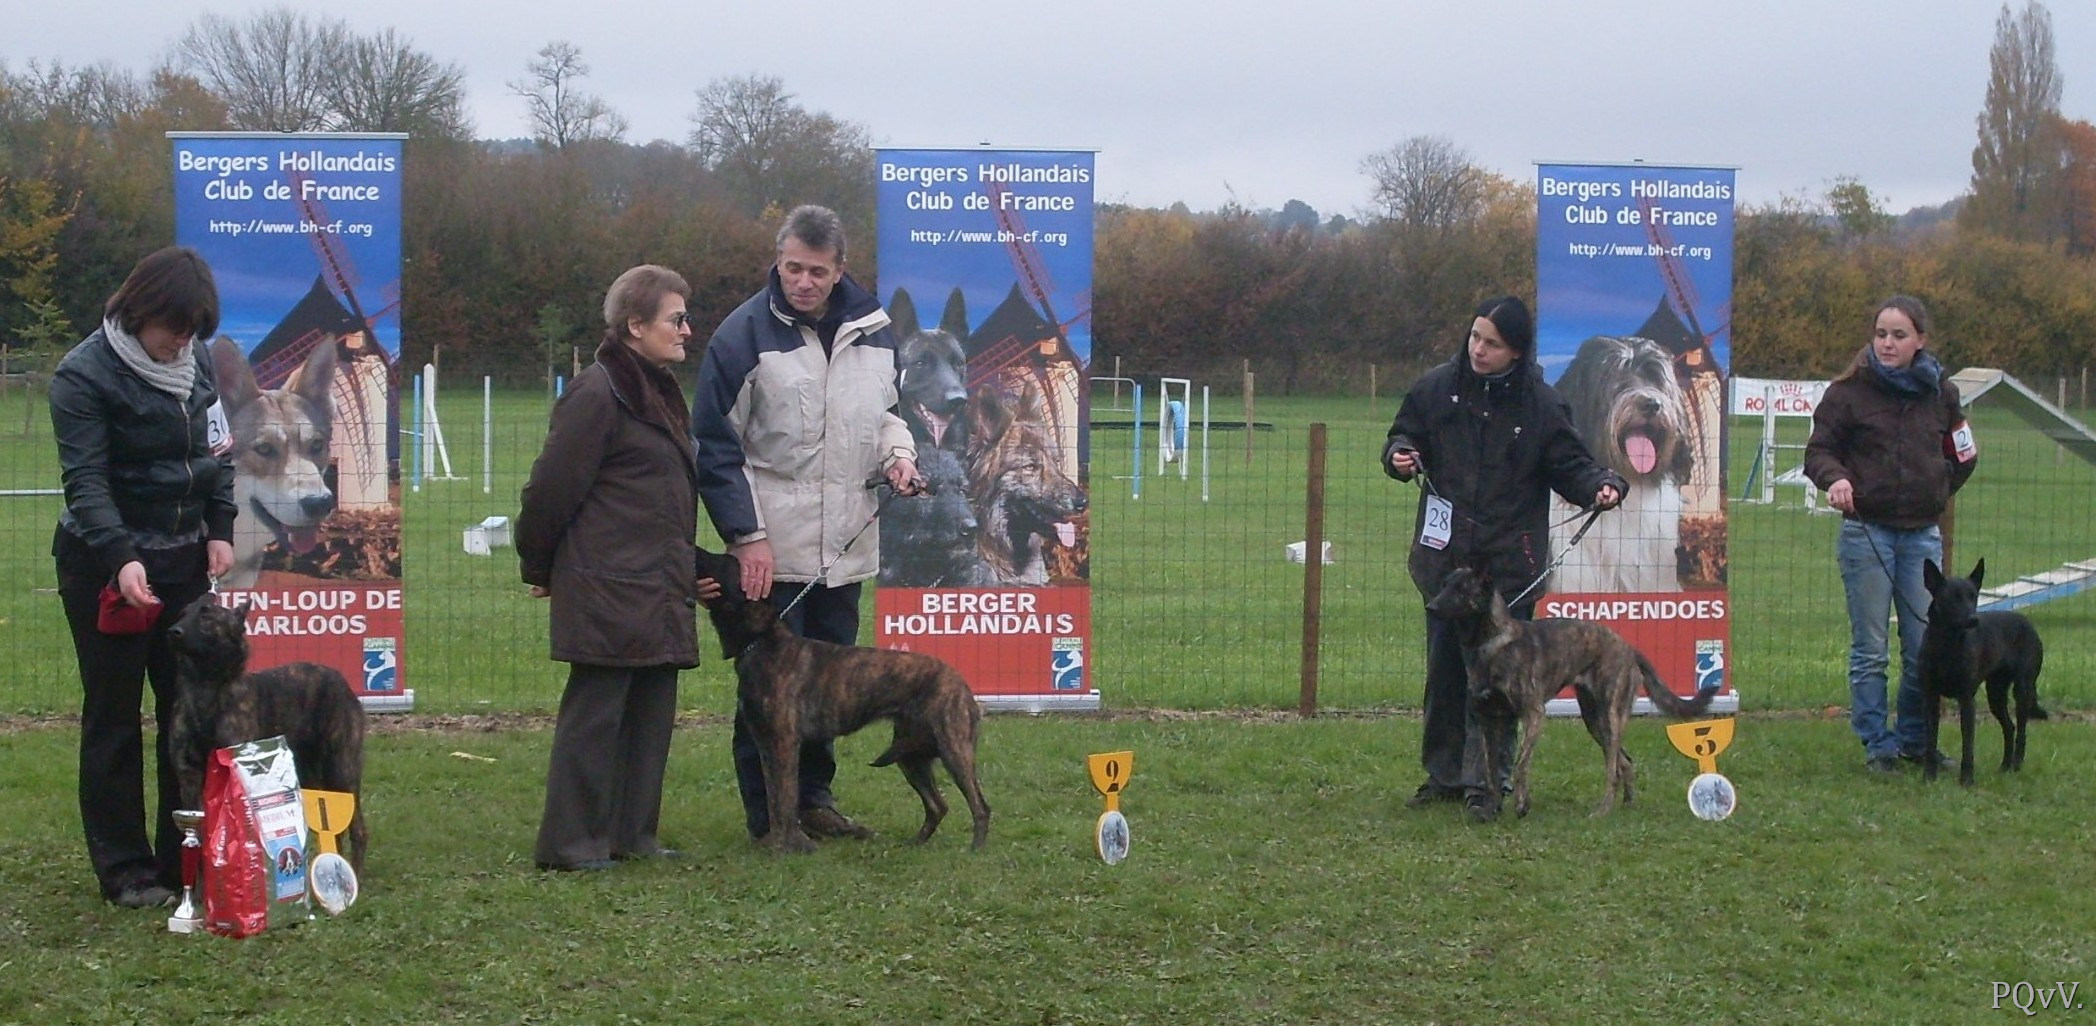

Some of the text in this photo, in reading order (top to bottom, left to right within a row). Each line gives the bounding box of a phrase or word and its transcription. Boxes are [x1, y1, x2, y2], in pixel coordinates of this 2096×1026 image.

[179, 150, 395, 177] Bergers Hollandais
[881, 163, 1090, 188] Bergers Hollandais
[204, 179, 380, 201] Club de France
[1542, 177, 1731, 202] Bergers Hollandais
[906, 191, 1075, 211] Club de France
[1565, 204, 1718, 226] Club de France
[209, 219, 373, 237] http://www.bh-cf.org
[910, 229, 1067, 247] http://www.bh-cf.org
[1569, 242, 1712, 260] http://www.bh-cf.org
[1745, 397, 1812, 412] ROAL CA
[1429, 507, 1449, 531] 28
[220, 589, 401, 611] IEN-LOUP DE
[922, 592, 1036, 614] BERGER
[1546, 600, 1725, 621] SCHAPENDOES
[884, 613, 1074, 635] HOLLANDAIS
[1694, 726, 1717, 757] 3
[1105, 759, 1119, 793] 2
[317, 796, 330, 832] 1
